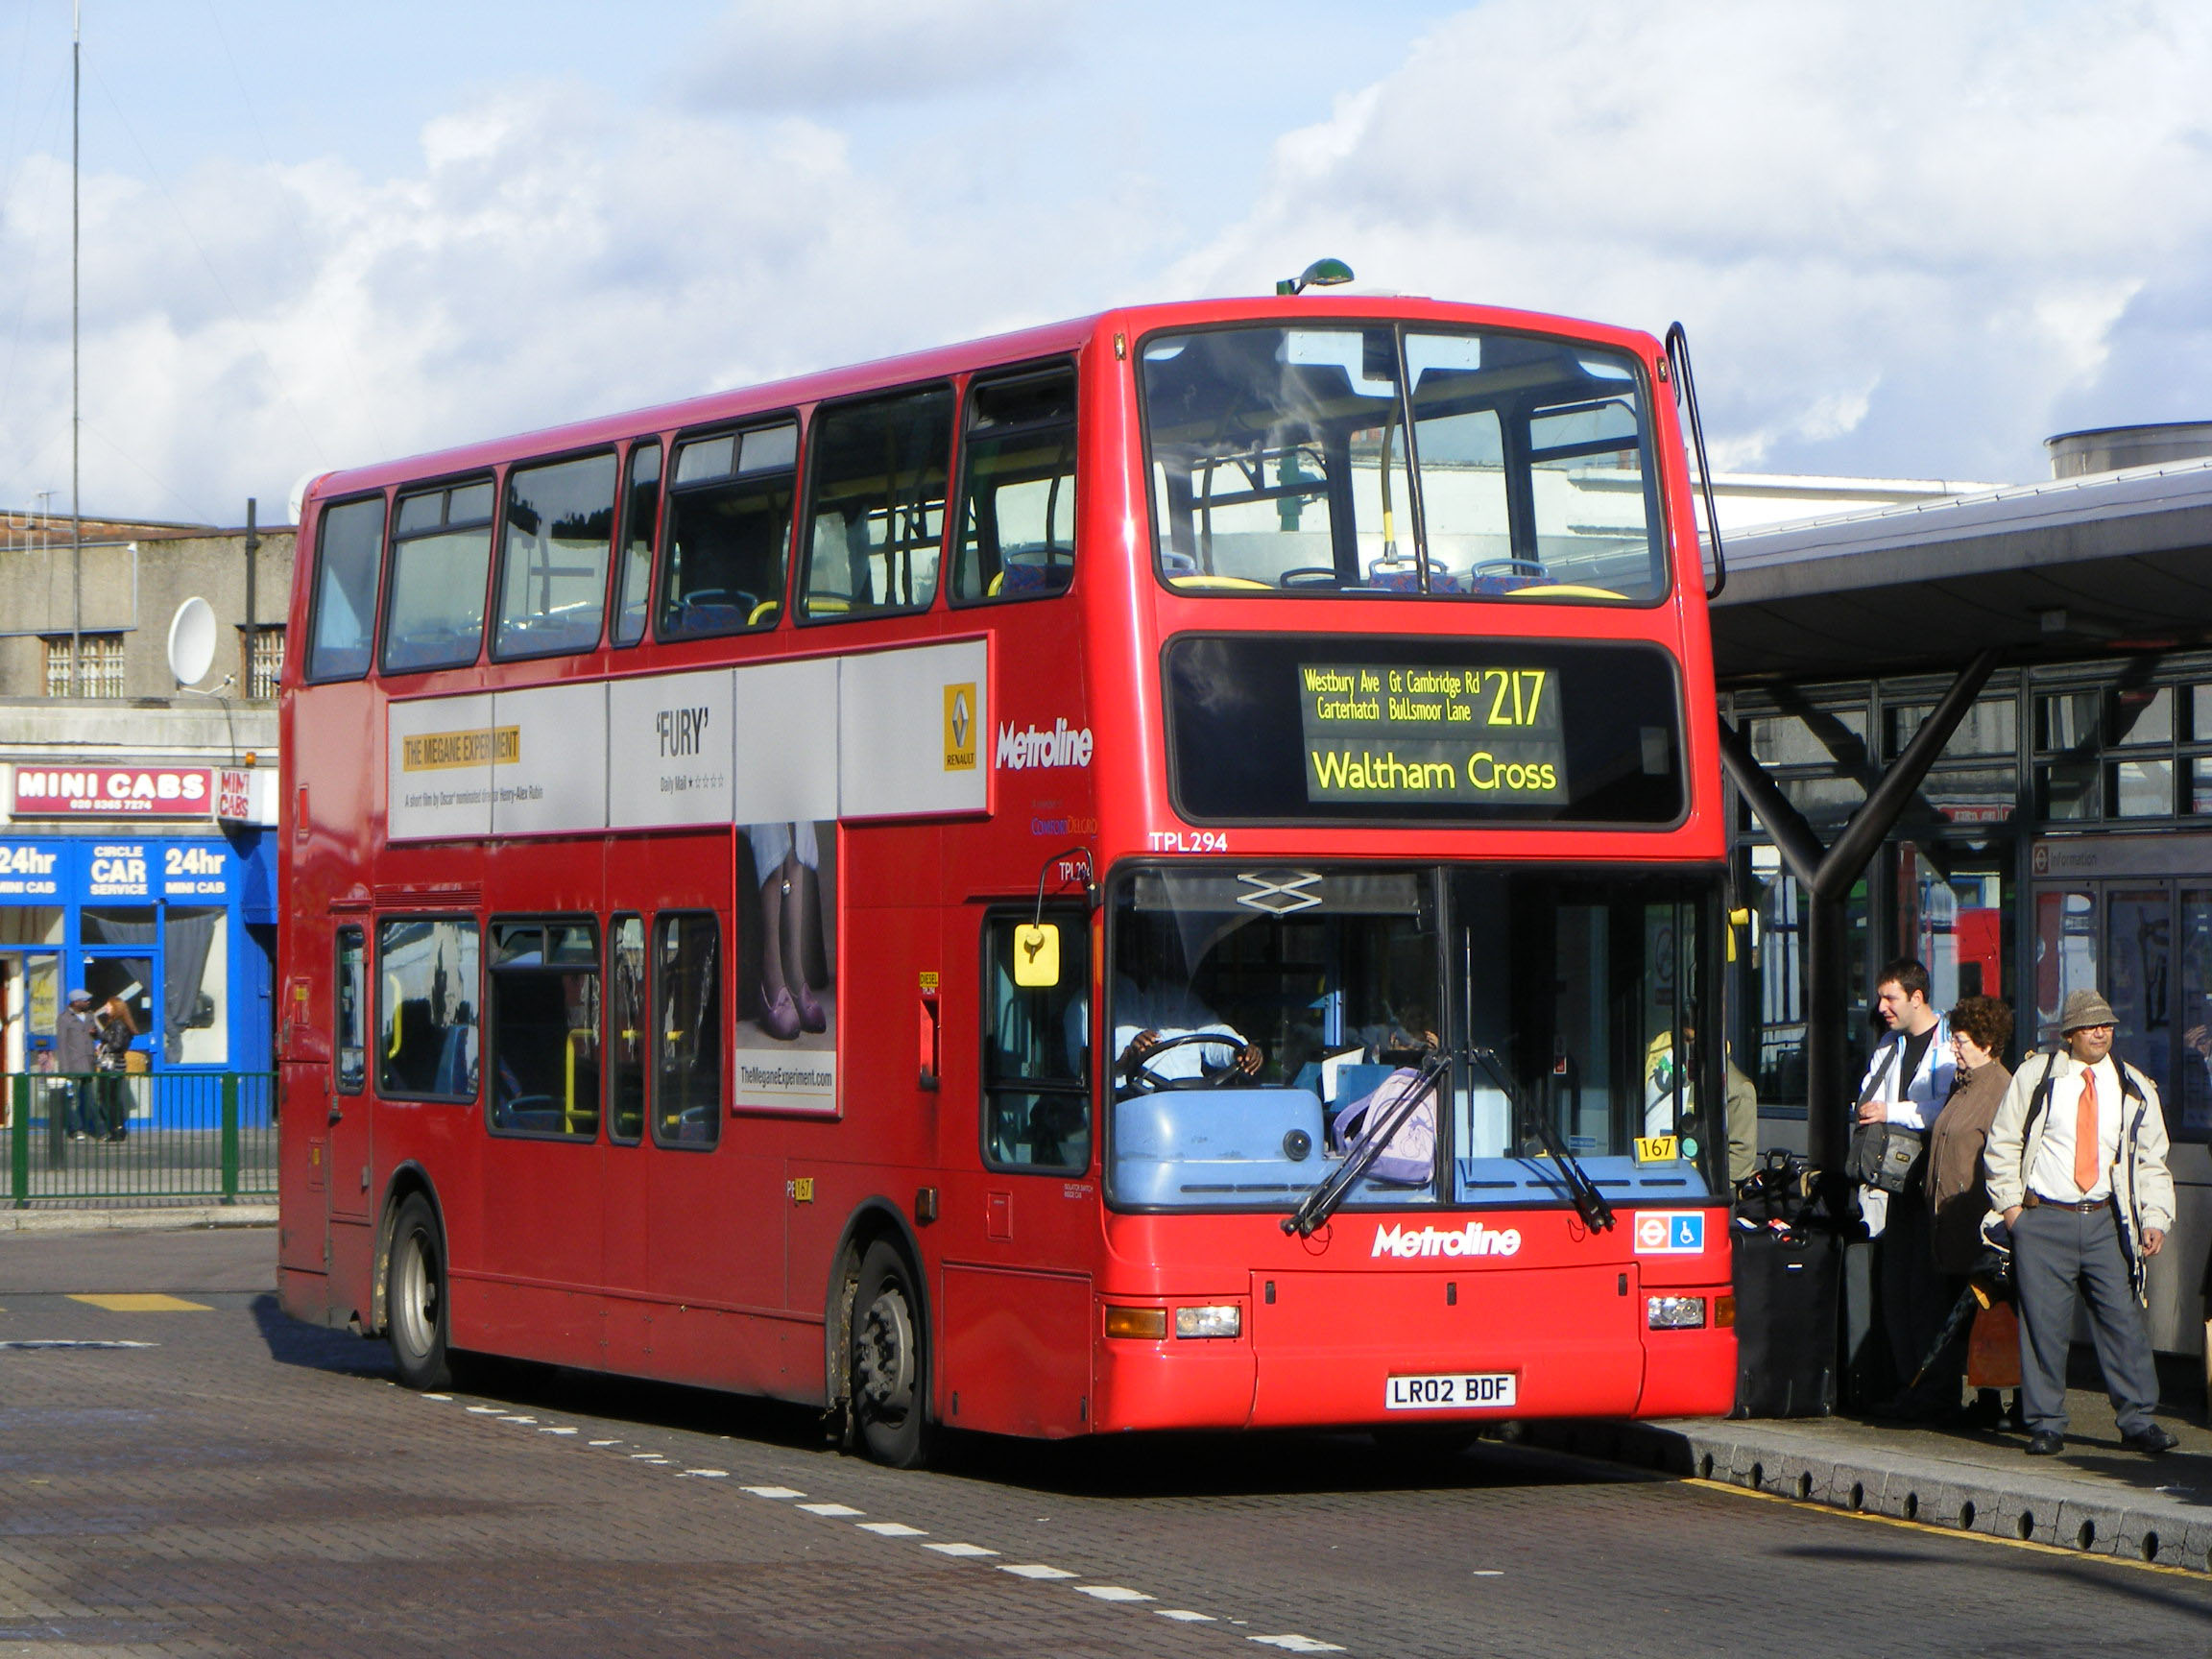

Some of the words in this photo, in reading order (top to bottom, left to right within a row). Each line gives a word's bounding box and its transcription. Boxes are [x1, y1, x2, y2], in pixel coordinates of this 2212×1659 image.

[1304, 669, 1355, 696] Westbury
[1359, 670, 1381, 692] Ave
[1388, 670, 1403, 693] Gt
[1407, 671, 1461, 699] Cambridge
[1464, 672, 1480, 694] Rd
[1316, 696, 1380, 720] Carterhatch
[1388, 697, 1442, 721] Bullsmoor
[1446, 699, 1472, 721] Lane
[1483, 671, 1546, 726] 217
[405, 740, 422, 765] THE
[423, 736, 462, 764] MEGANE
[463, 731, 518, 761] EXPERMENT
[996, 717, 1094, 770] Metroline
[947, 753, 975, 766] RENAULT
[1311, 751, 1455, 790] Waltham
[1467, 752, 1557, 790] Cross
[18, 772, 99, 798] MINI
[107, 774, 205, 800] CABS
[220, 795, 249, 818] CABS
[94, 846, 144, 858] CIRCLE
[1149, 832, 1228, 853] TPL294
[0, 847, 57, 875] 24hr
[90, 859, 147, 883] CAR
[165, 848, 227, 876] 24hr
[26, 881, 57, 895] CAB
[90, 884, 148, 896] SERVICE
[165, 881, 195, 894] MINI
[196, 881, 227, 894] CAB
[921, 974, 938, 985] DIESEL
[740, 1066, 832, 1089] TheMeganeExperiment.com
[1643, 1138, 1671, 1157] 167
[797, 1180, 810, 1197] 167
[1371, 1222, 1522, 1258] Metroline
[1394, 1380, 1455, 1403] LR02
[1466, 1378, 1509, 1402] BDF
